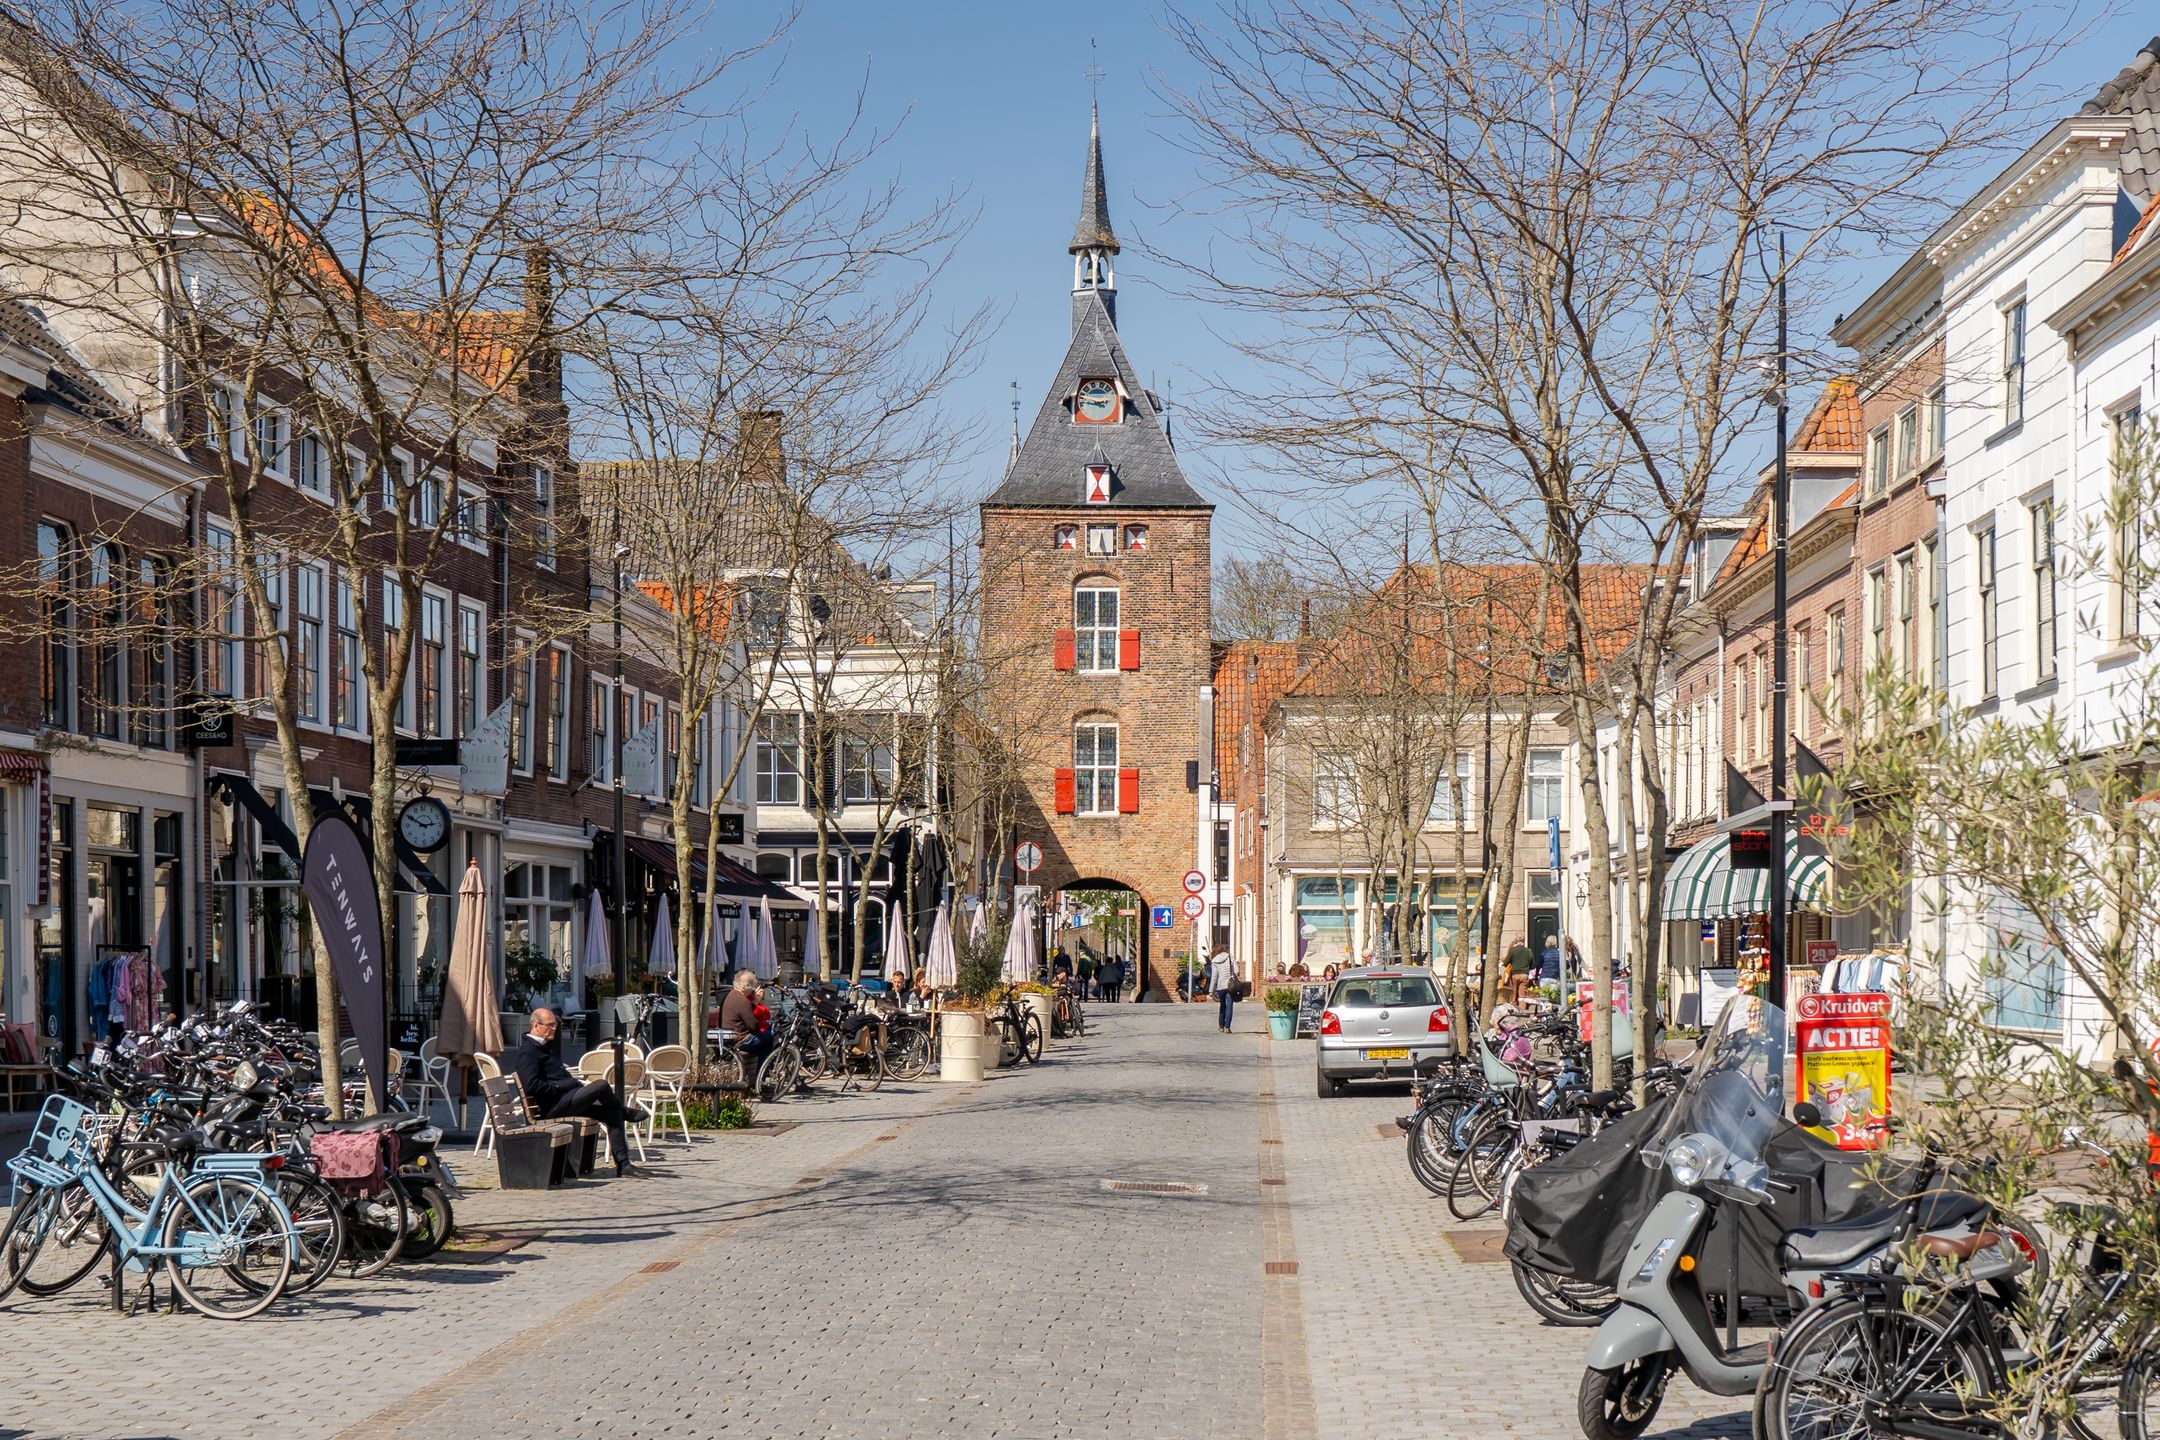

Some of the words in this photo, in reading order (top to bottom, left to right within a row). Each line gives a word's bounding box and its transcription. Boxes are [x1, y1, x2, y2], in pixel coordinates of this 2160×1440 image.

[1733, 842, 1770, 851] ston
[326, 853, 373, 983] TENWAYS
[1821, 998, 1885, 1014] Kruidvat
[1807, 1027, 1880, 1048] ACTIE!
[127, 1182, 152, 1206] BATAVU
